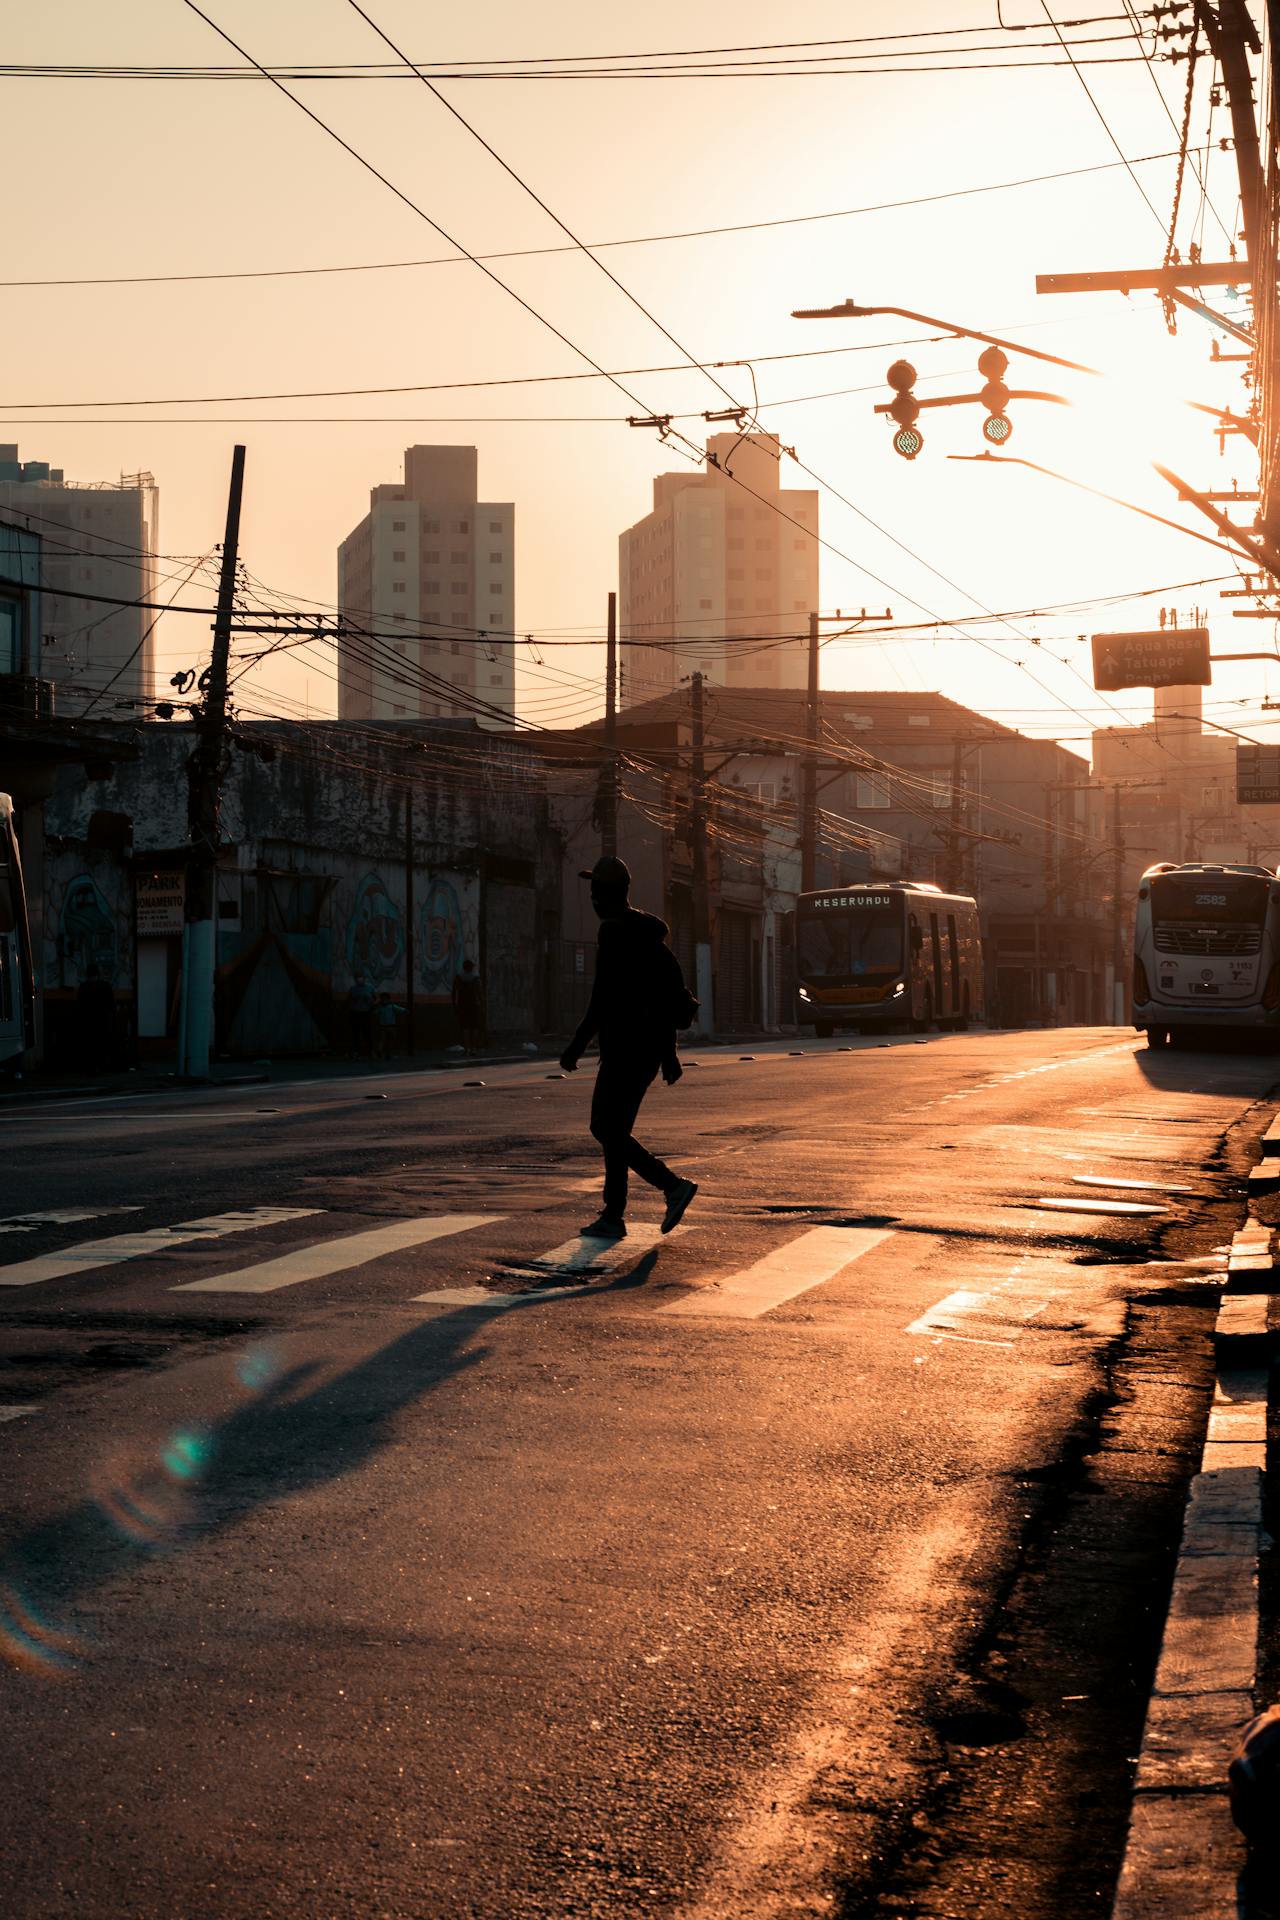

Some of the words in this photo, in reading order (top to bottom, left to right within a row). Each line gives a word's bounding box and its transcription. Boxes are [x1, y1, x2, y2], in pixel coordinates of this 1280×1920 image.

[1167, 638, 1201, 650] Rasa
[1123, 652, 1184, 669] Tatuapé
[1195, 894, 1226, 906] 2582
